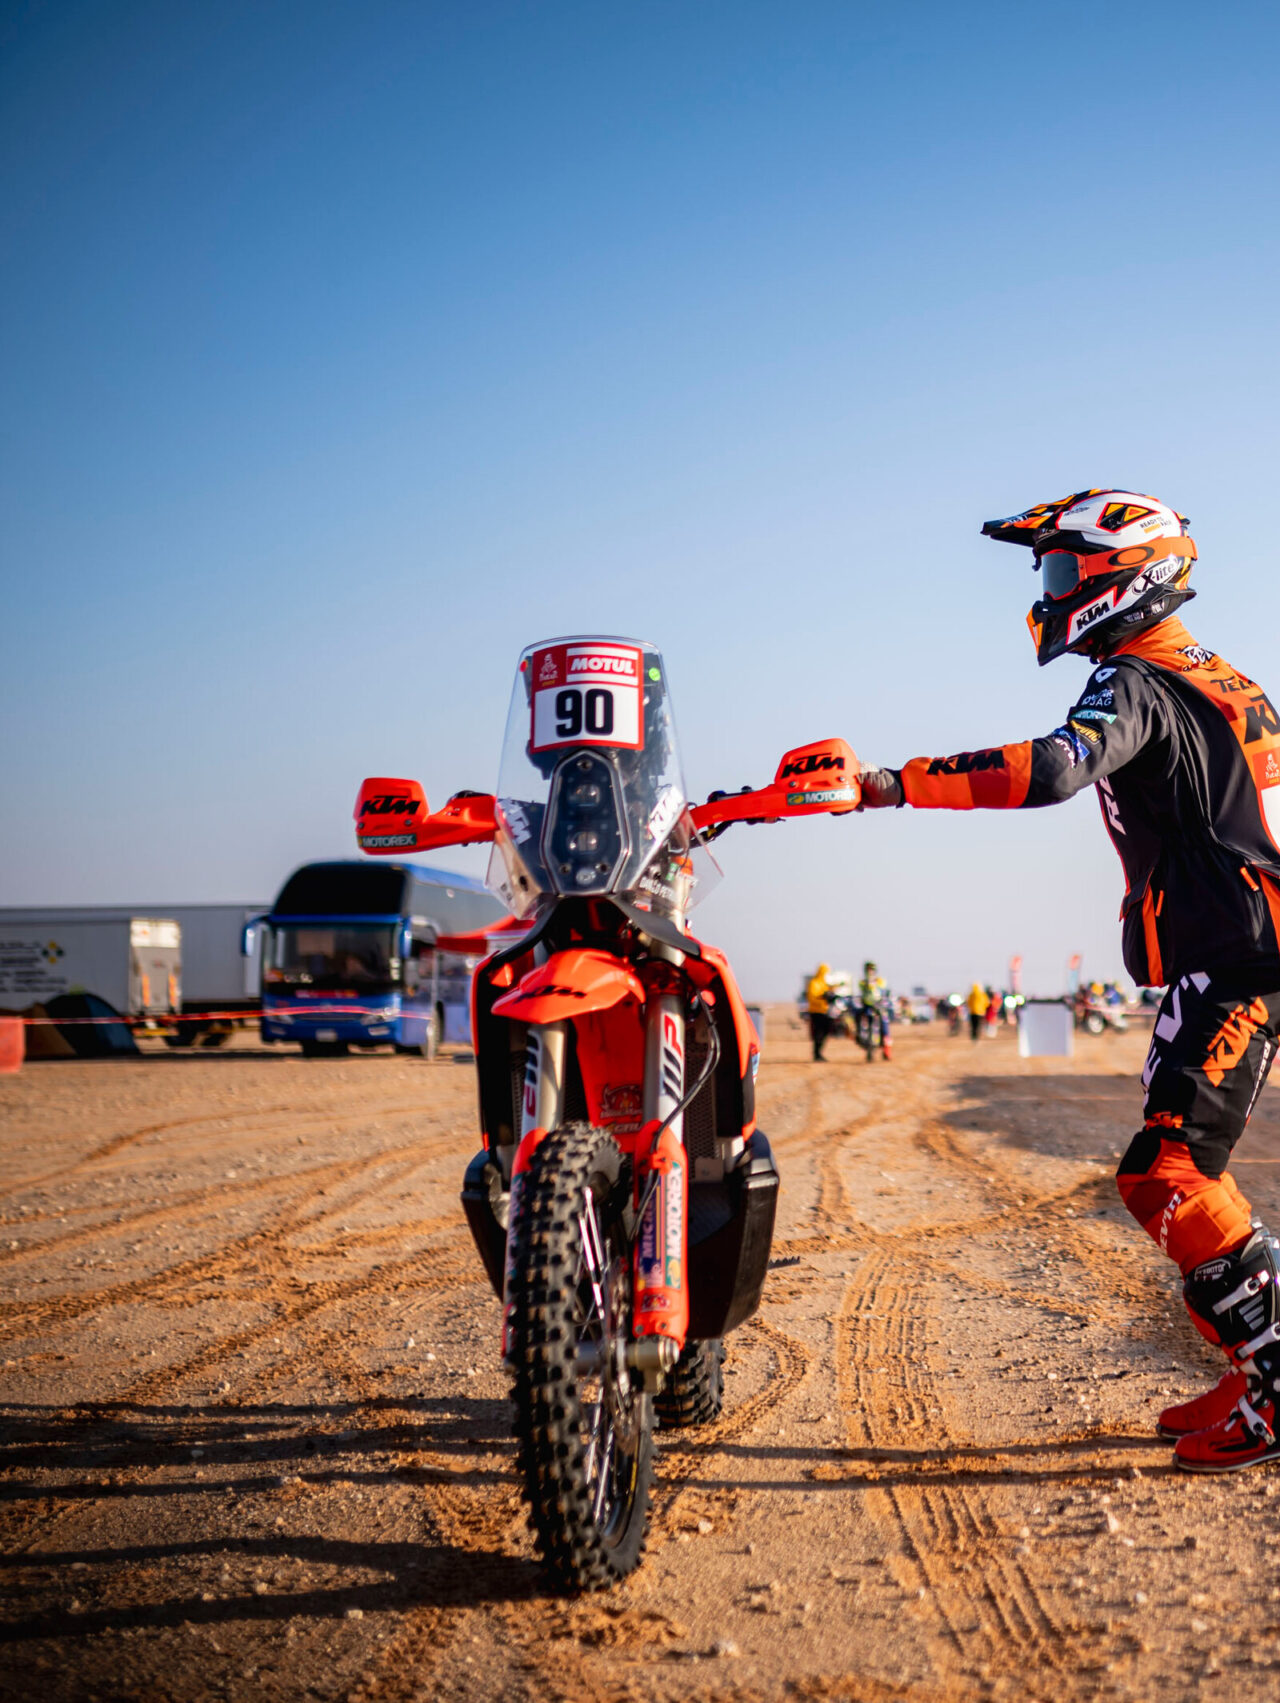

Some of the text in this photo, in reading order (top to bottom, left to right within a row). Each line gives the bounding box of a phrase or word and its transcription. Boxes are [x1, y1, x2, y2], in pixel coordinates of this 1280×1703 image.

[1076, 601, 1111, 632] KTM
[570, 657, 634, 675] MOTUL
[555, 688, 614, 738] 90
[781, 752, 845, 779] KTM
[926, 749, 1005, 776] KTM
[359, 795, 420, 817] KTM
[805, 789, 855, 803] MOTOREX
[362, 835, 415, 849] MOTOREX
